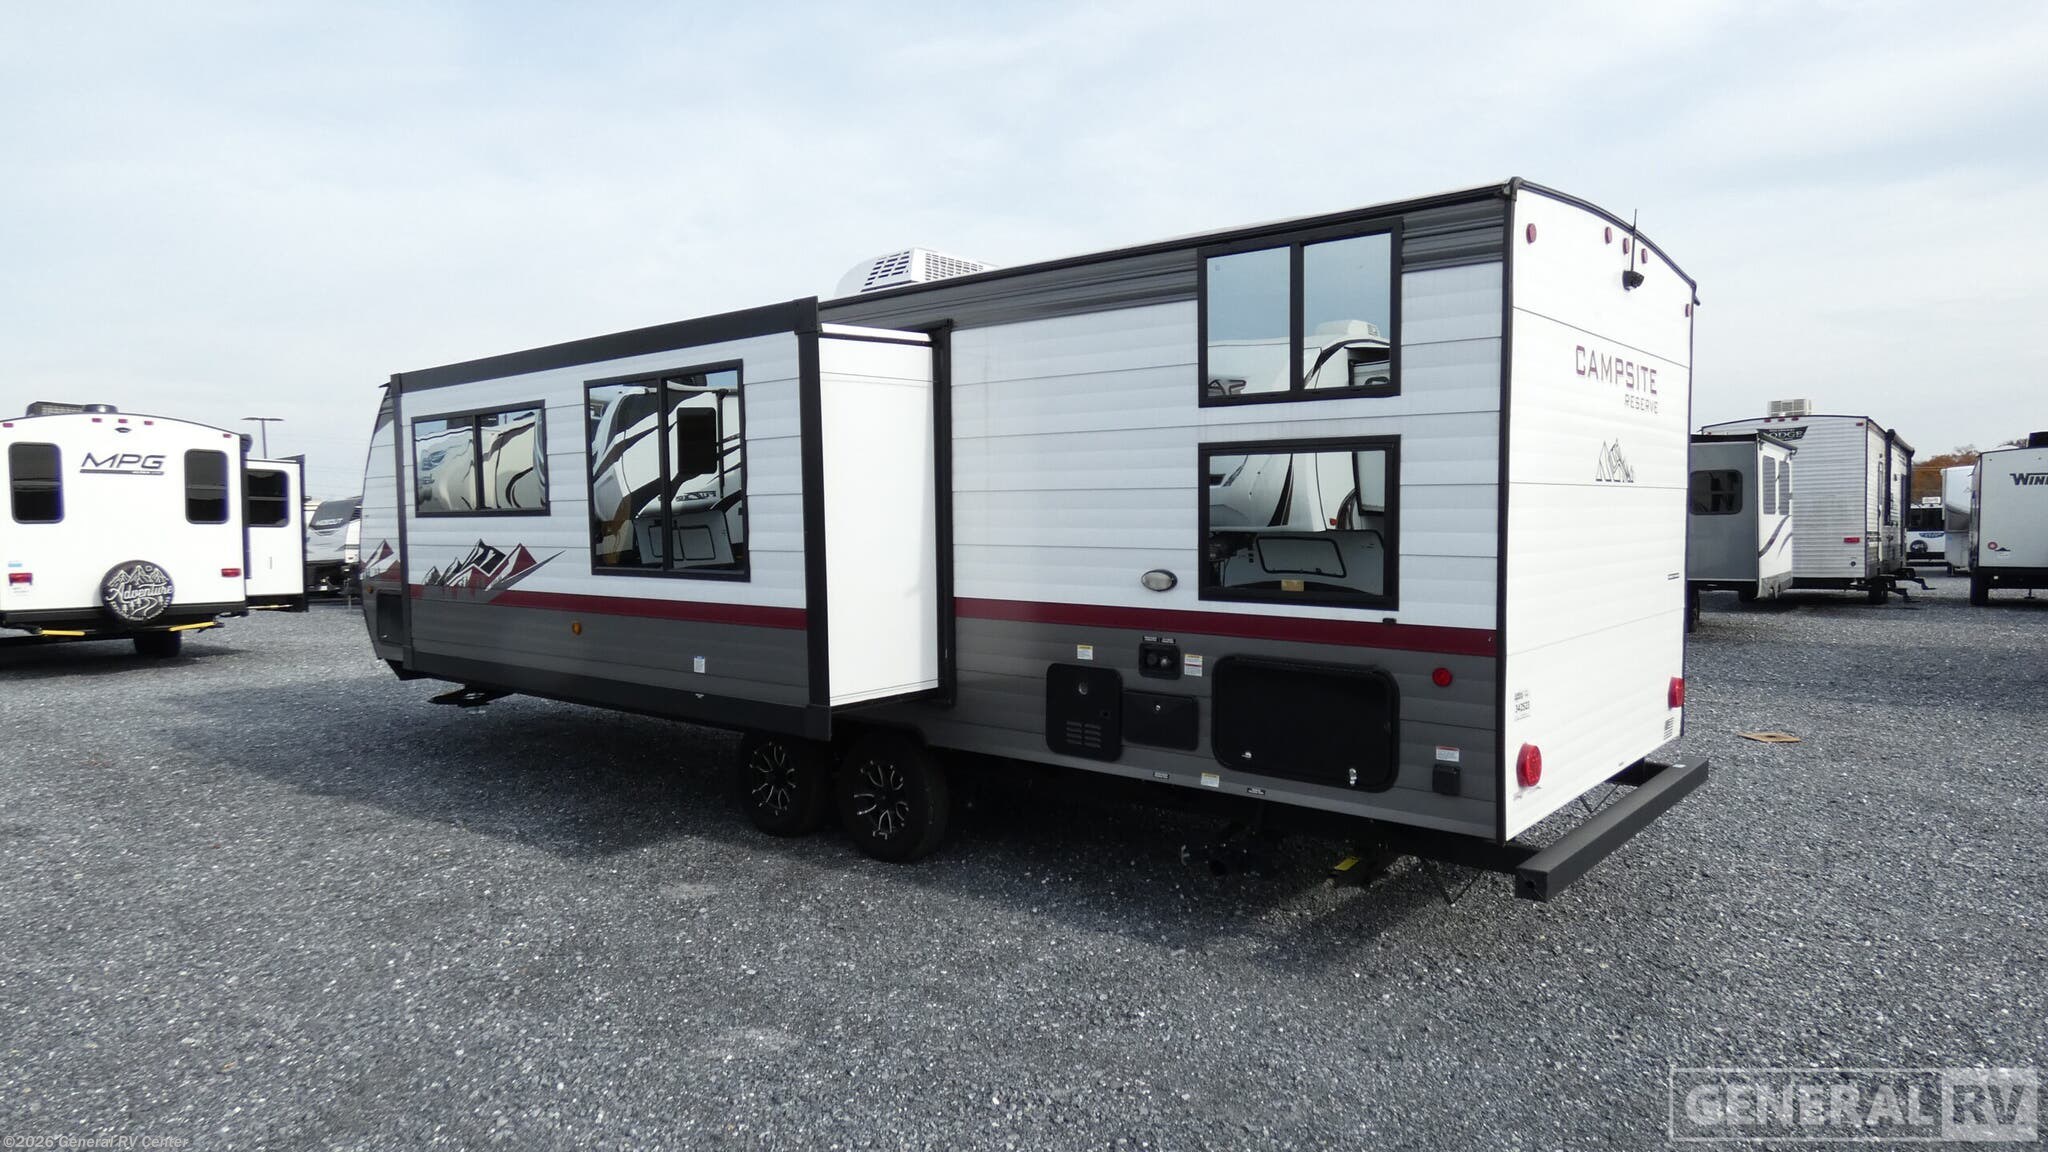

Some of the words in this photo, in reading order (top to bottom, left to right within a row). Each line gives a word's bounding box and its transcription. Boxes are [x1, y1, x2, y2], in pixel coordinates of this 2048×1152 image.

[1576, 345, 1657, 394] CAMPSITE
[1624, 394, 1658, 415] RESERVE
[81, 452, 166, 469] MPG
[106, 582, 174, 604] Adventure
